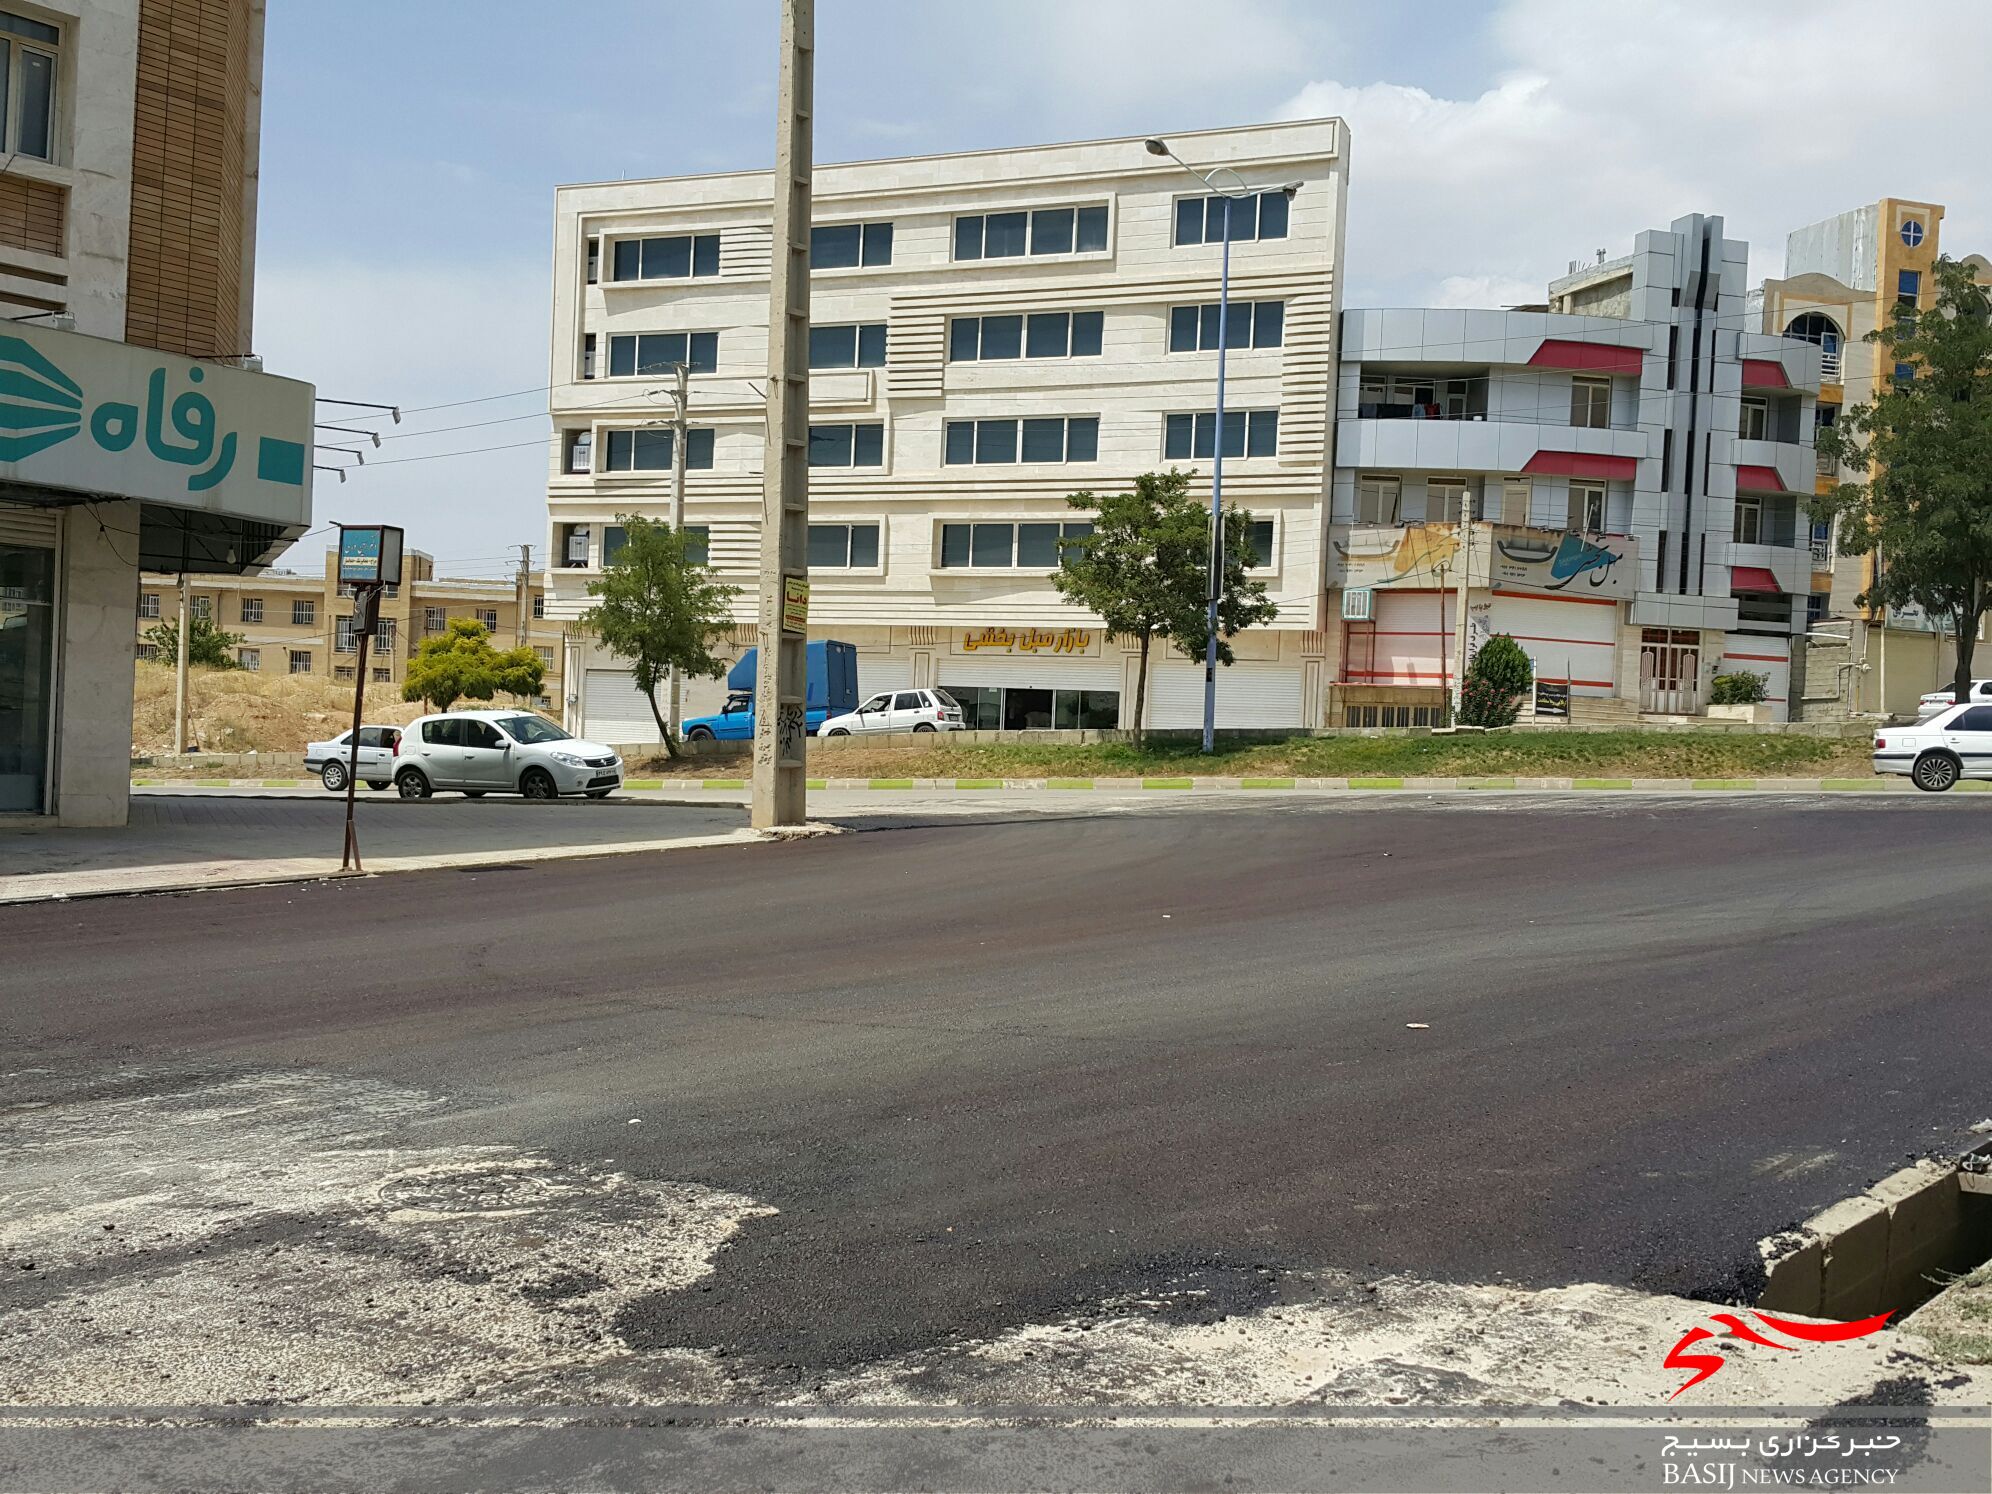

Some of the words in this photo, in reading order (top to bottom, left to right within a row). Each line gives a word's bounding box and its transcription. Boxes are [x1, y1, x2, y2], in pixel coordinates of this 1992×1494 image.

[91, 366, 238, 491] رفاه
[963, 627, 1016, 653] بخشی
[1019, 627, 1054, 653] مبل
[1053, 627, 1090, 654] بازار
